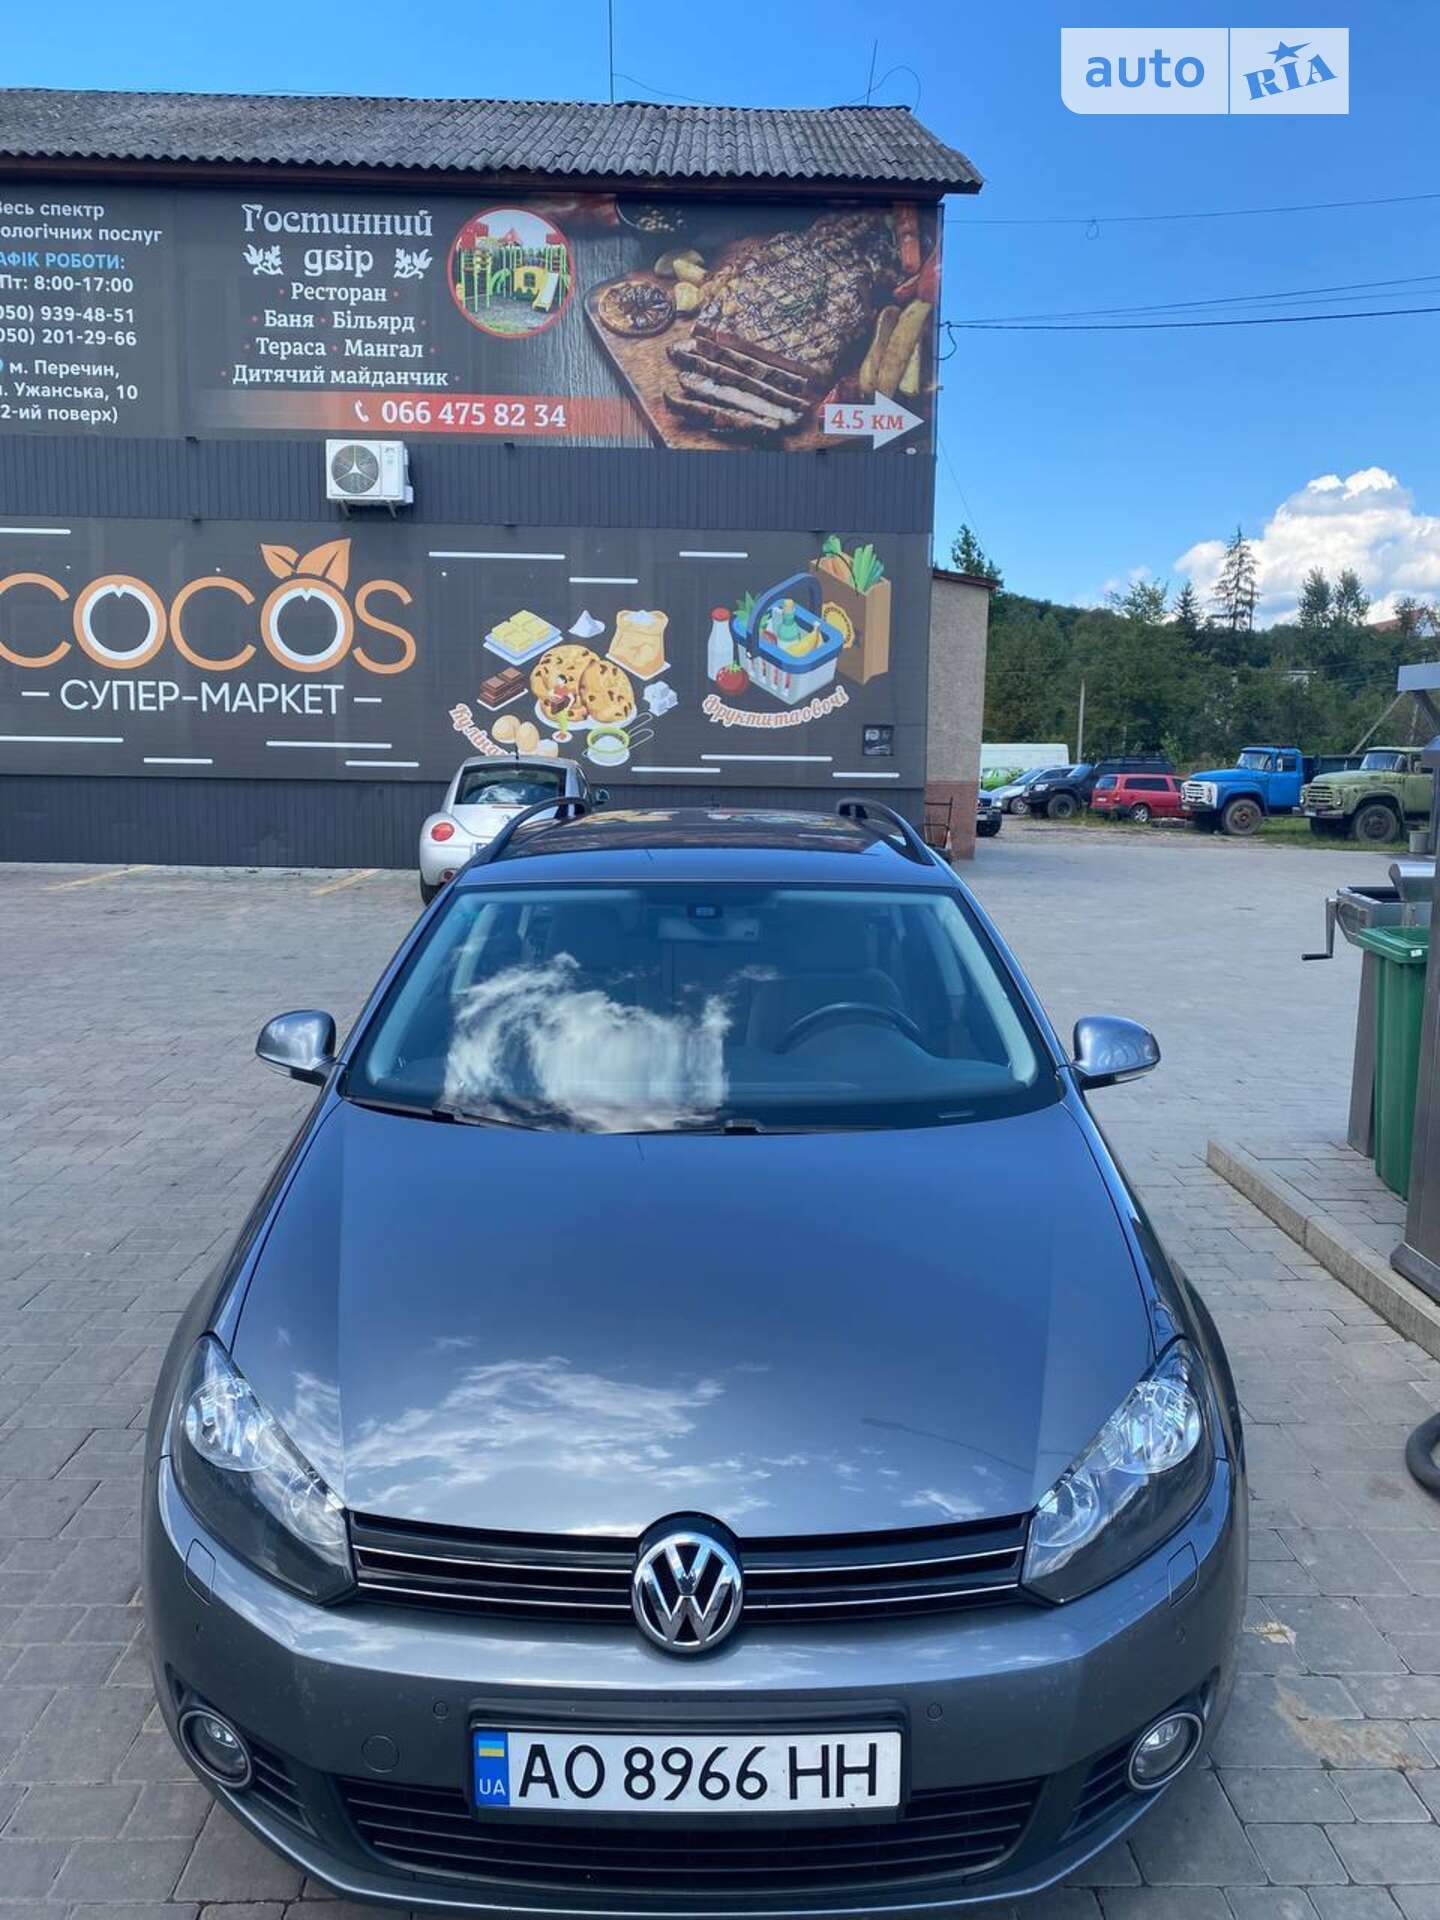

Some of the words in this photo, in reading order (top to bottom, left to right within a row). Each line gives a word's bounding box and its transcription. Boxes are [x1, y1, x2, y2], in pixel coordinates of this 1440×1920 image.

[40, 204, 104, 221] спектр
[241, 203, 433, 237] Гостинний
[0, 223, 92, 240] ологічних
[99, 227, 163, 245] послуг
[45, 253, 125, 270] РОБОТИ:
[304, 245, 373, 277] двір
[34, 275, 134, 293] 8:00-17:00
[291, 282, 387, 305] Ресторан
[41, 305, 134, 323] 939-48-51
[263, 309, 315, 329] Баня
[332, 310, 415, 334] Більярд
[42, 328, 137, 346] 201-29-66
[256, 337, 327, 360] Тераса
[344, 339, 423, 359] Мангал
[9, 361, 28, 374] м.
[34, 359, 120, 379] Перечин,
[233, 364, 326, 386] Дитячий
[330, 367, 449, 388] майданчик
[14, 381, 109, 402] Ужанська,
[116, 385, 138, 400] 10
[48, 407, 118, 425] поверх)
[382, 400, 432, 425] 066
[438, 401, 486, 426] 475
[494, 404, 526, 428] 82
[534, 405, 567, 428] 34
[831, 409, 865, 430] 4.5
[0, 571, 417, 675] COCOS
[60, 678, 345, 715] СУПЕР-МАРКЕТ
[518, 1743, 606, 1800] AO
[623, 1745, 769, 1801] 8966
[787, 1742, 878, 1801] HH
[479, 1779, 506, 1797] UA
